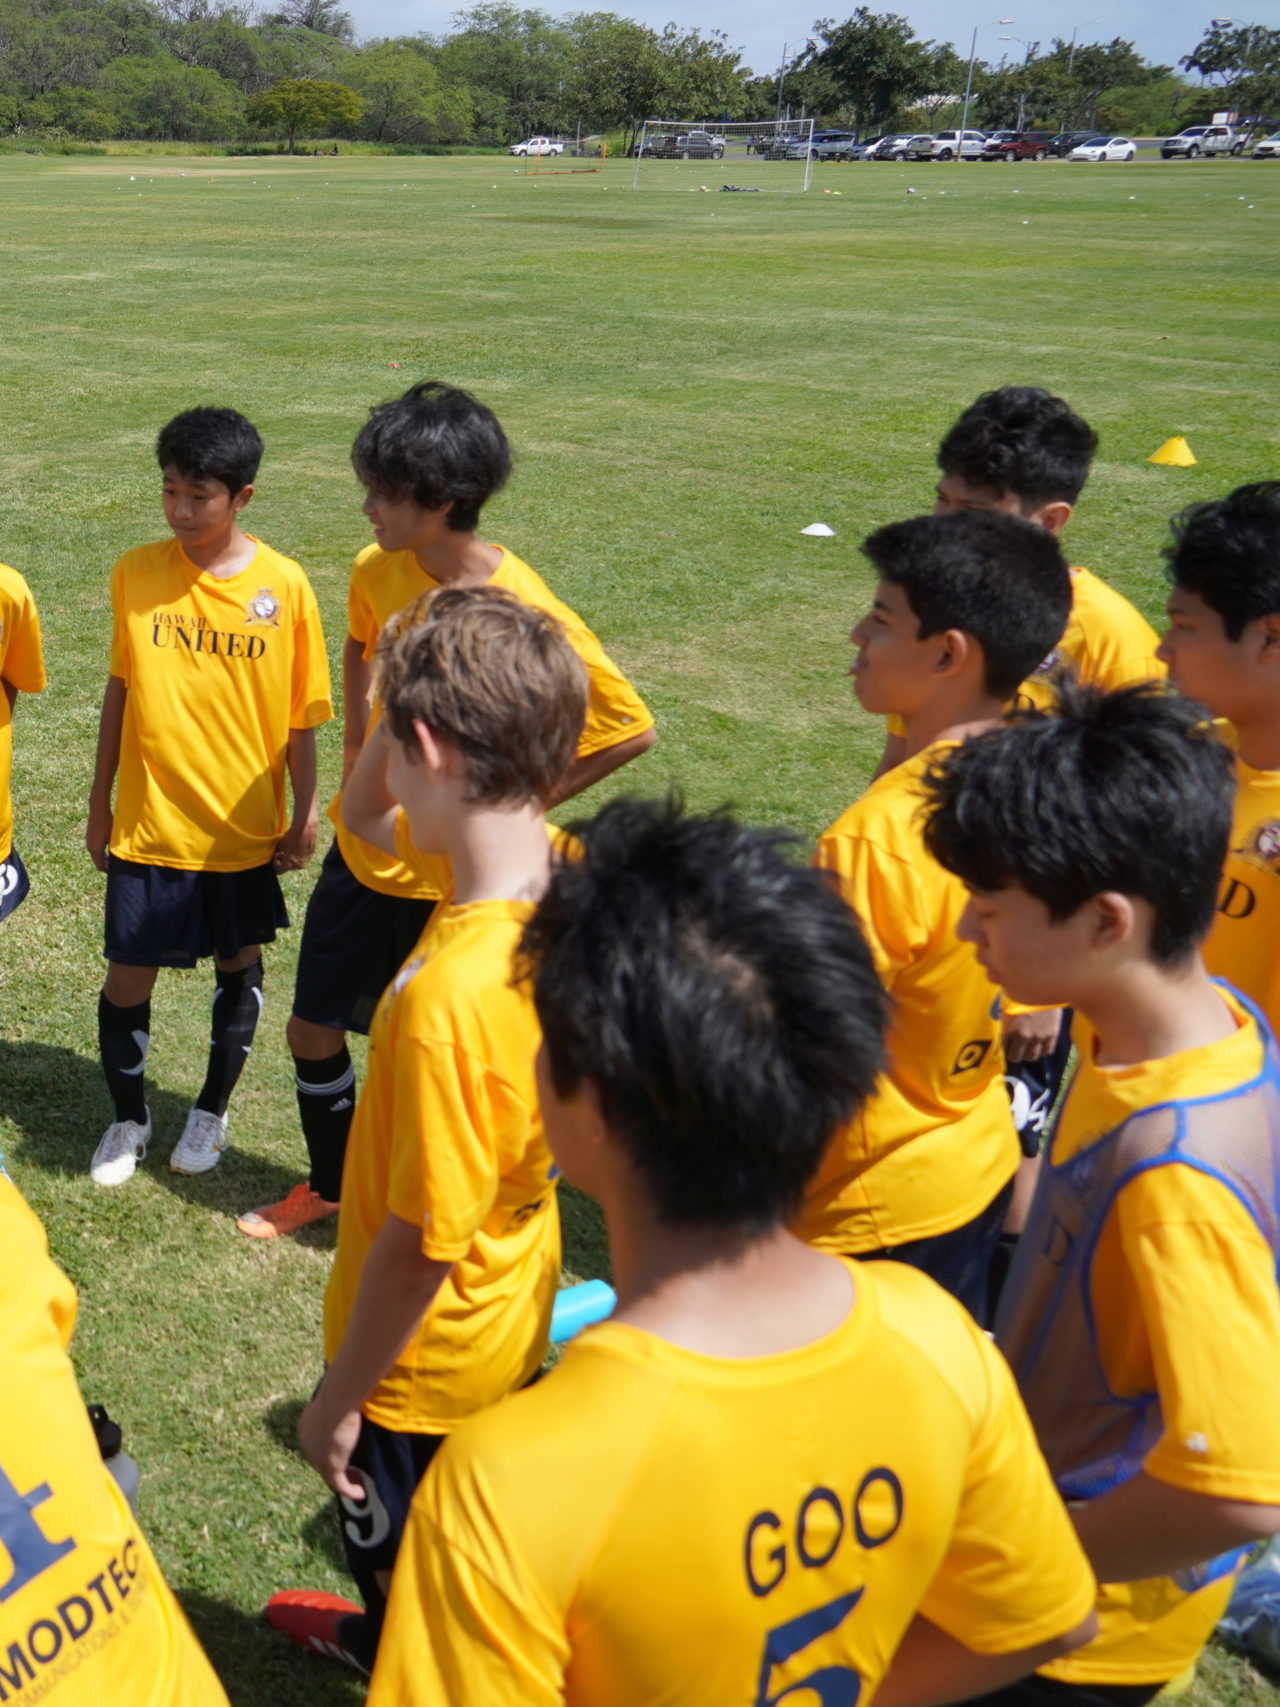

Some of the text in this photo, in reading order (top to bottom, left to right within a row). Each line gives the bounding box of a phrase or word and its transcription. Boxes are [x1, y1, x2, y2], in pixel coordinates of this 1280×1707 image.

[152, 624, 266, 660] UNITED
[153, 612, 207, 629] HAWAII
[341, 1465, 391, 1548] 9
[744, 1465, 904, 1598] GOO
